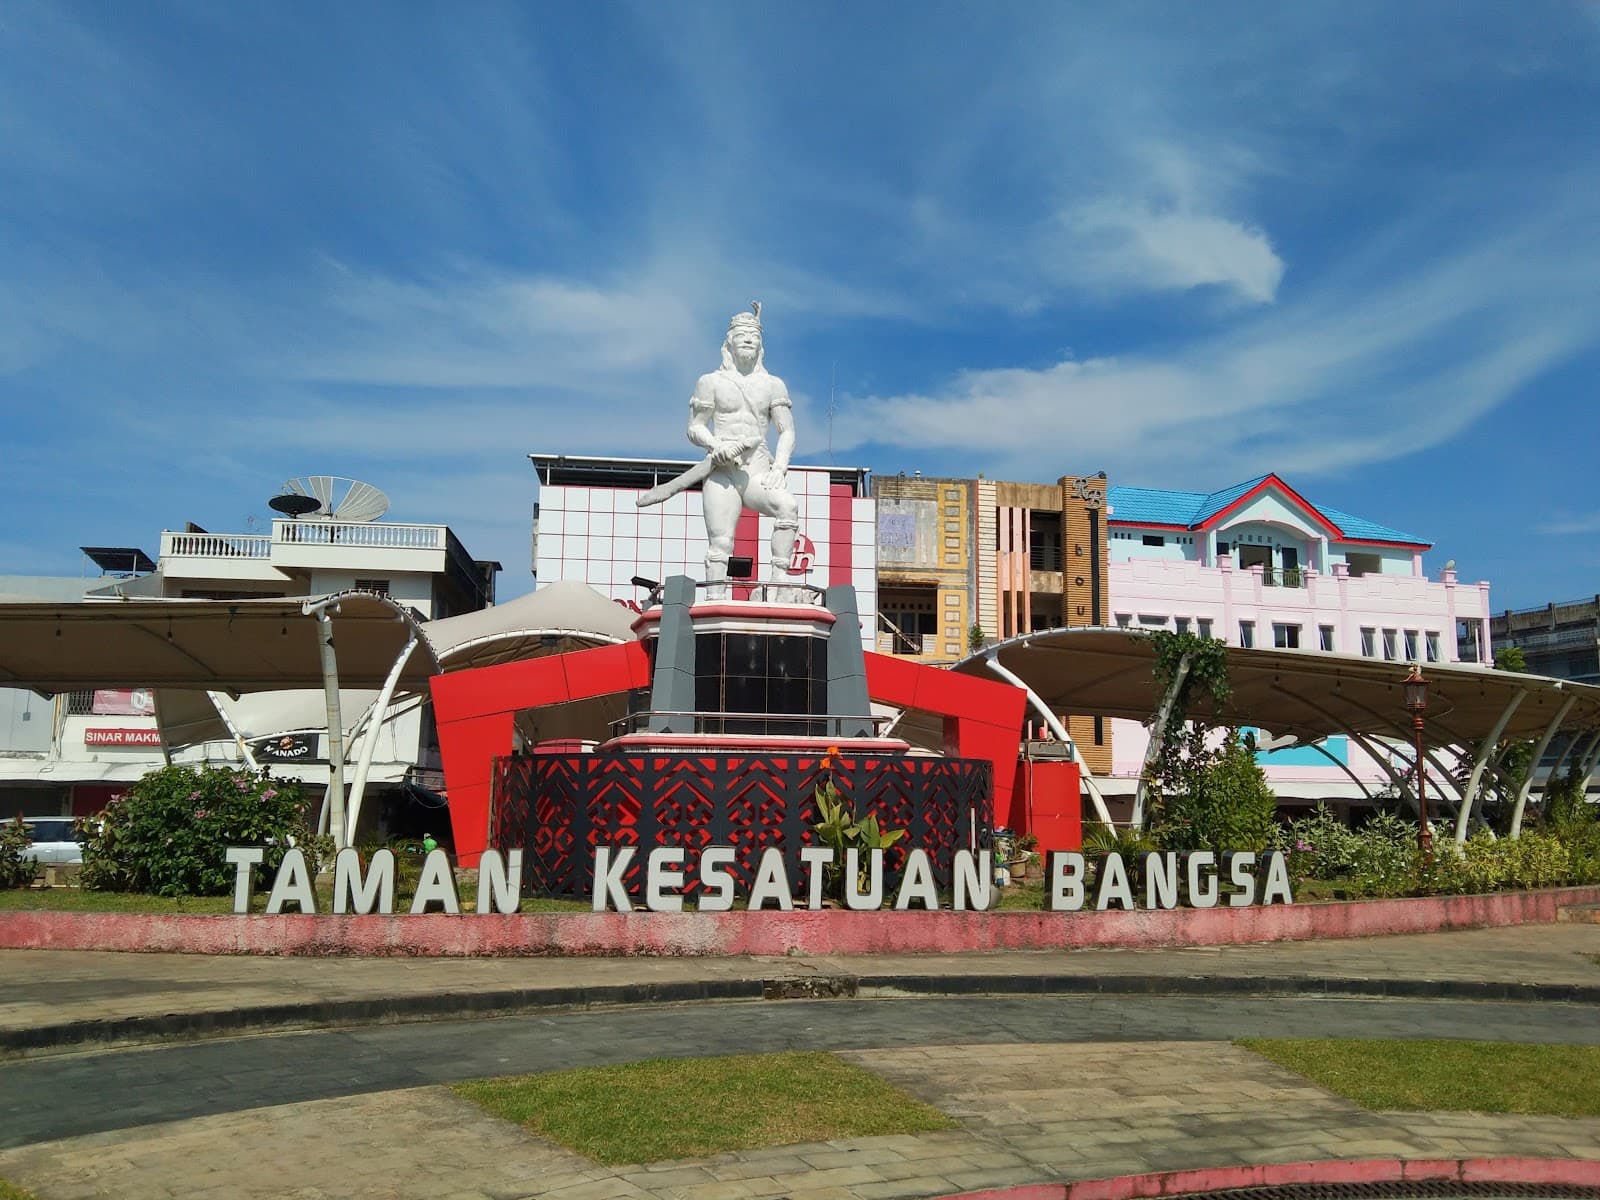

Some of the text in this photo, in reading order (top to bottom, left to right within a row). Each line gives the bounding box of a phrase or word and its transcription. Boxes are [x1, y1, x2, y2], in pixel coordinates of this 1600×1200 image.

[86, 732, 160, 743] SINAR MAKM
[225, 845, 1293, 914] TAMAN KESATUAN BANGSA
